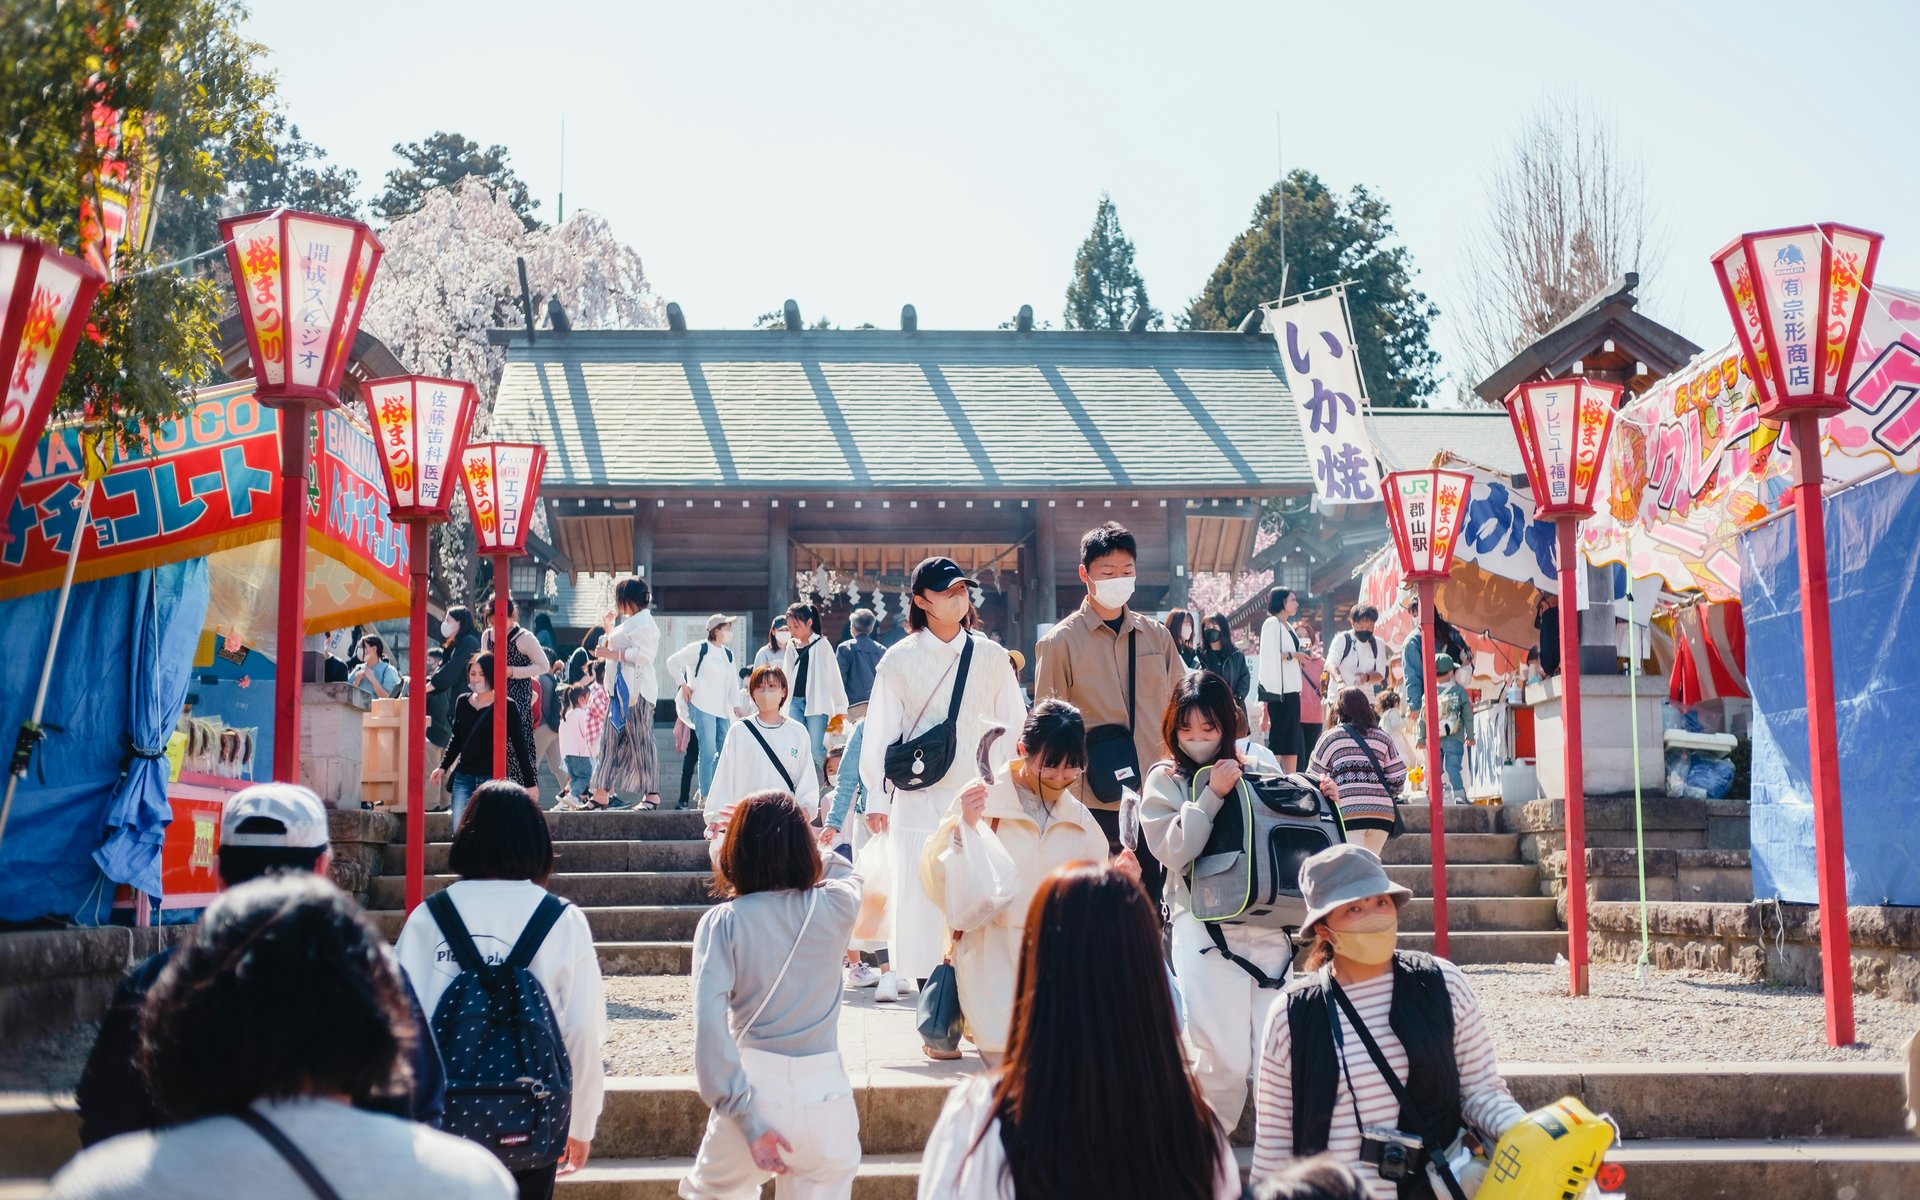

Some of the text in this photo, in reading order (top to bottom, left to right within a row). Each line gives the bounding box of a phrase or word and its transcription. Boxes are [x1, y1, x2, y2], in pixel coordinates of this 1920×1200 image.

[246, 234, 283, 365] 桜まつり
[299, 241, 330, 369] 開成スタジオ
[1825, 248, 1858, 378] 桜まつり
[381, 395, 412, 492] 桜まつり
[421, 390, 448, 500] 佐藤歯科医院
[1286, 321, 1375, 500] いか焼
[1576, 397, 1604, 490] 桜まつり
[468, 456, 495, 534] 桜まつり
[1402, 479, 1430, 495] JR
[1409, 502, 1428, 553] 郡山駅
[1434, 484, 1458, 560] 桜まつり
